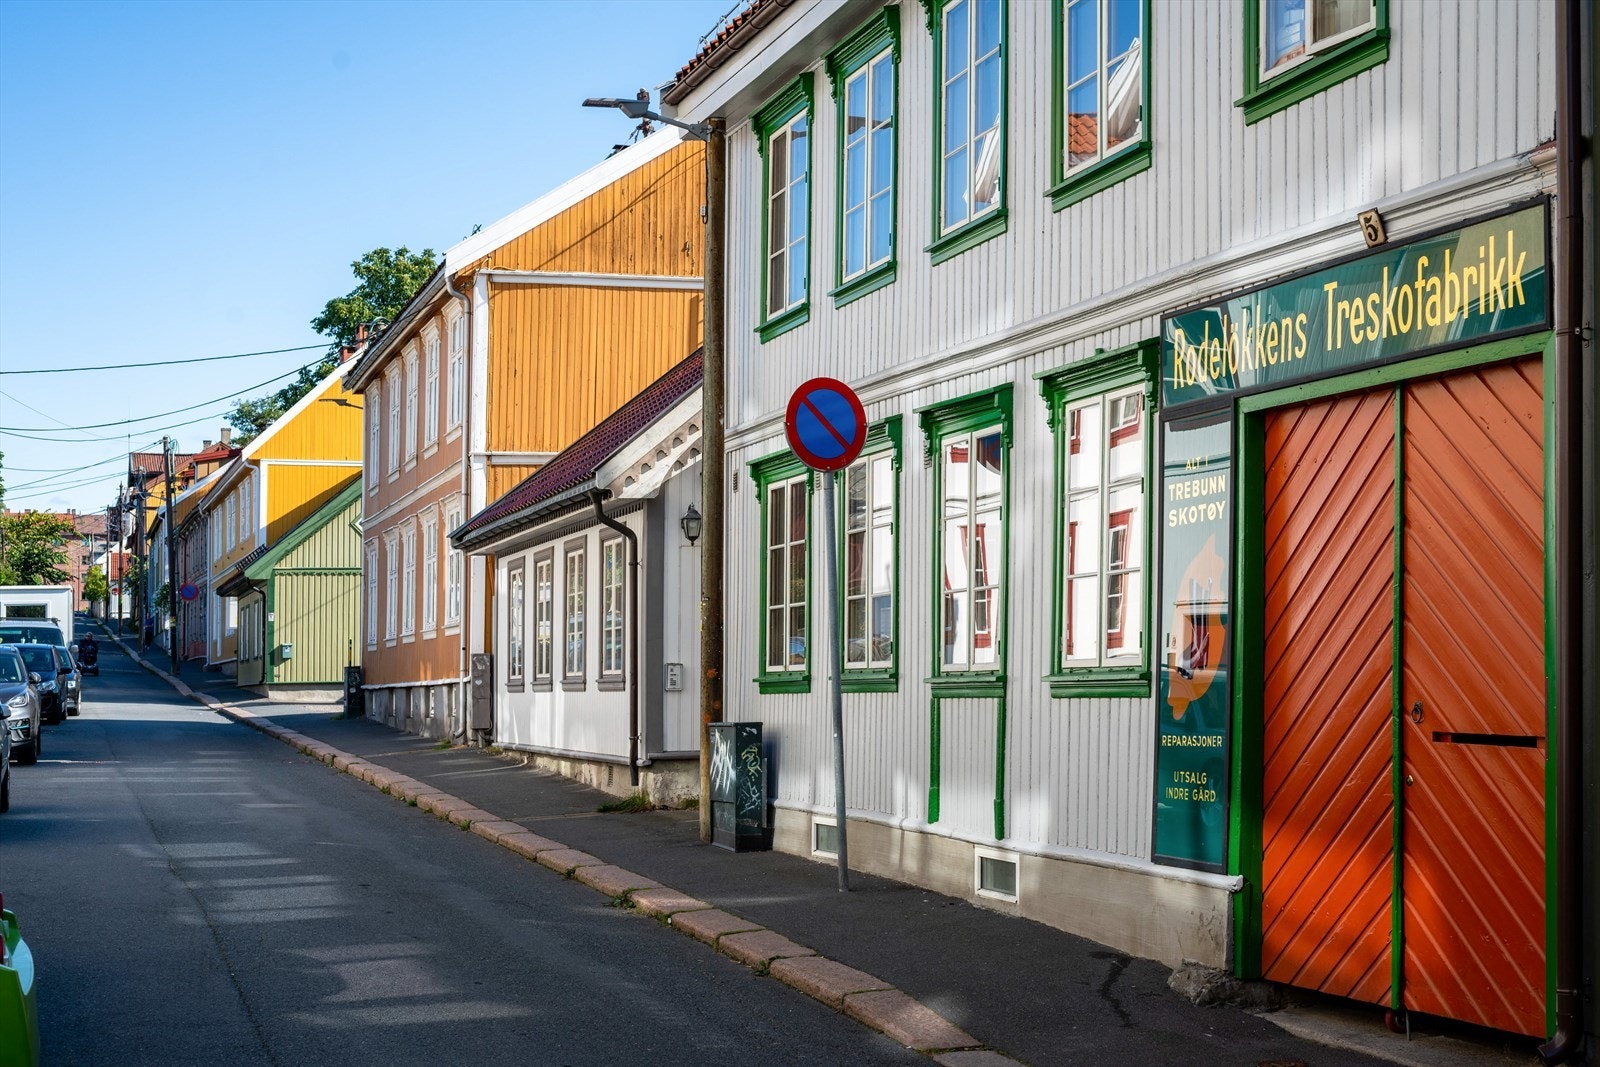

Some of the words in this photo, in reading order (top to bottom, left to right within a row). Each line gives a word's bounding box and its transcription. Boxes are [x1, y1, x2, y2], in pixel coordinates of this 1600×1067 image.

[1363, 214, 1379, 242] 5
[1173, 304, 1307, 390] Rodelökkens
[1323, 230, 1527, 351] Treskofabrikk
[1185, 456, 1200, 470] ALT
[1168, 474, 1226, 501] TREBUNN
[1168, 500, 1226, 527] SKOTØY
[1162, 735, 1222, 747] REPARASJONER
[1173, 771, 1207, 785] UTSALG
[1165, 787, 1189, 801] INDRE
[1192, 787, 1216, 802] GÅRD
